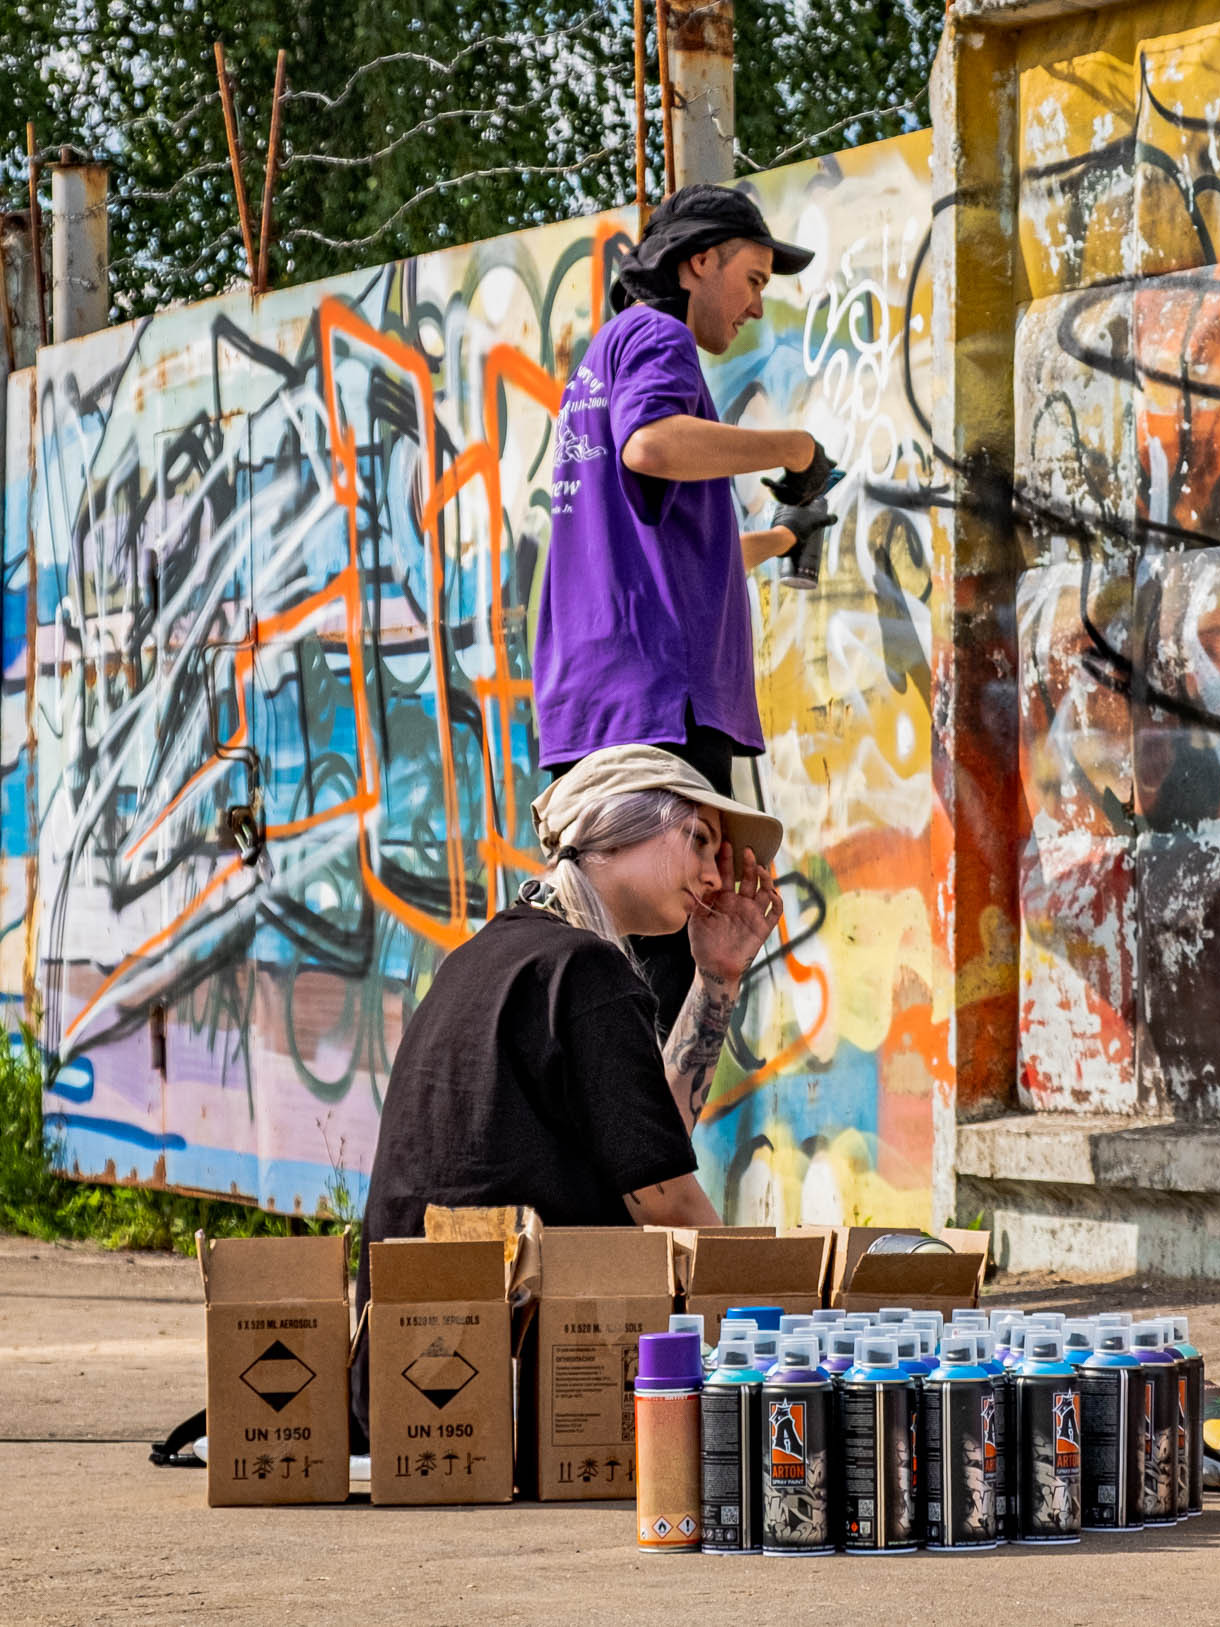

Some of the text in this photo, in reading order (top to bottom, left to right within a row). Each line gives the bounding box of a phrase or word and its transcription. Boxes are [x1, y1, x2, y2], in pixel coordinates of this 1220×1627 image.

[279, 1318, 318, 1329] AEROSOLS
[245, 1427, 311, 1441] UN 1950
[407, 1424, 474, 1438] UN 1950
[773, 1464, 805, 1478] ARTON
